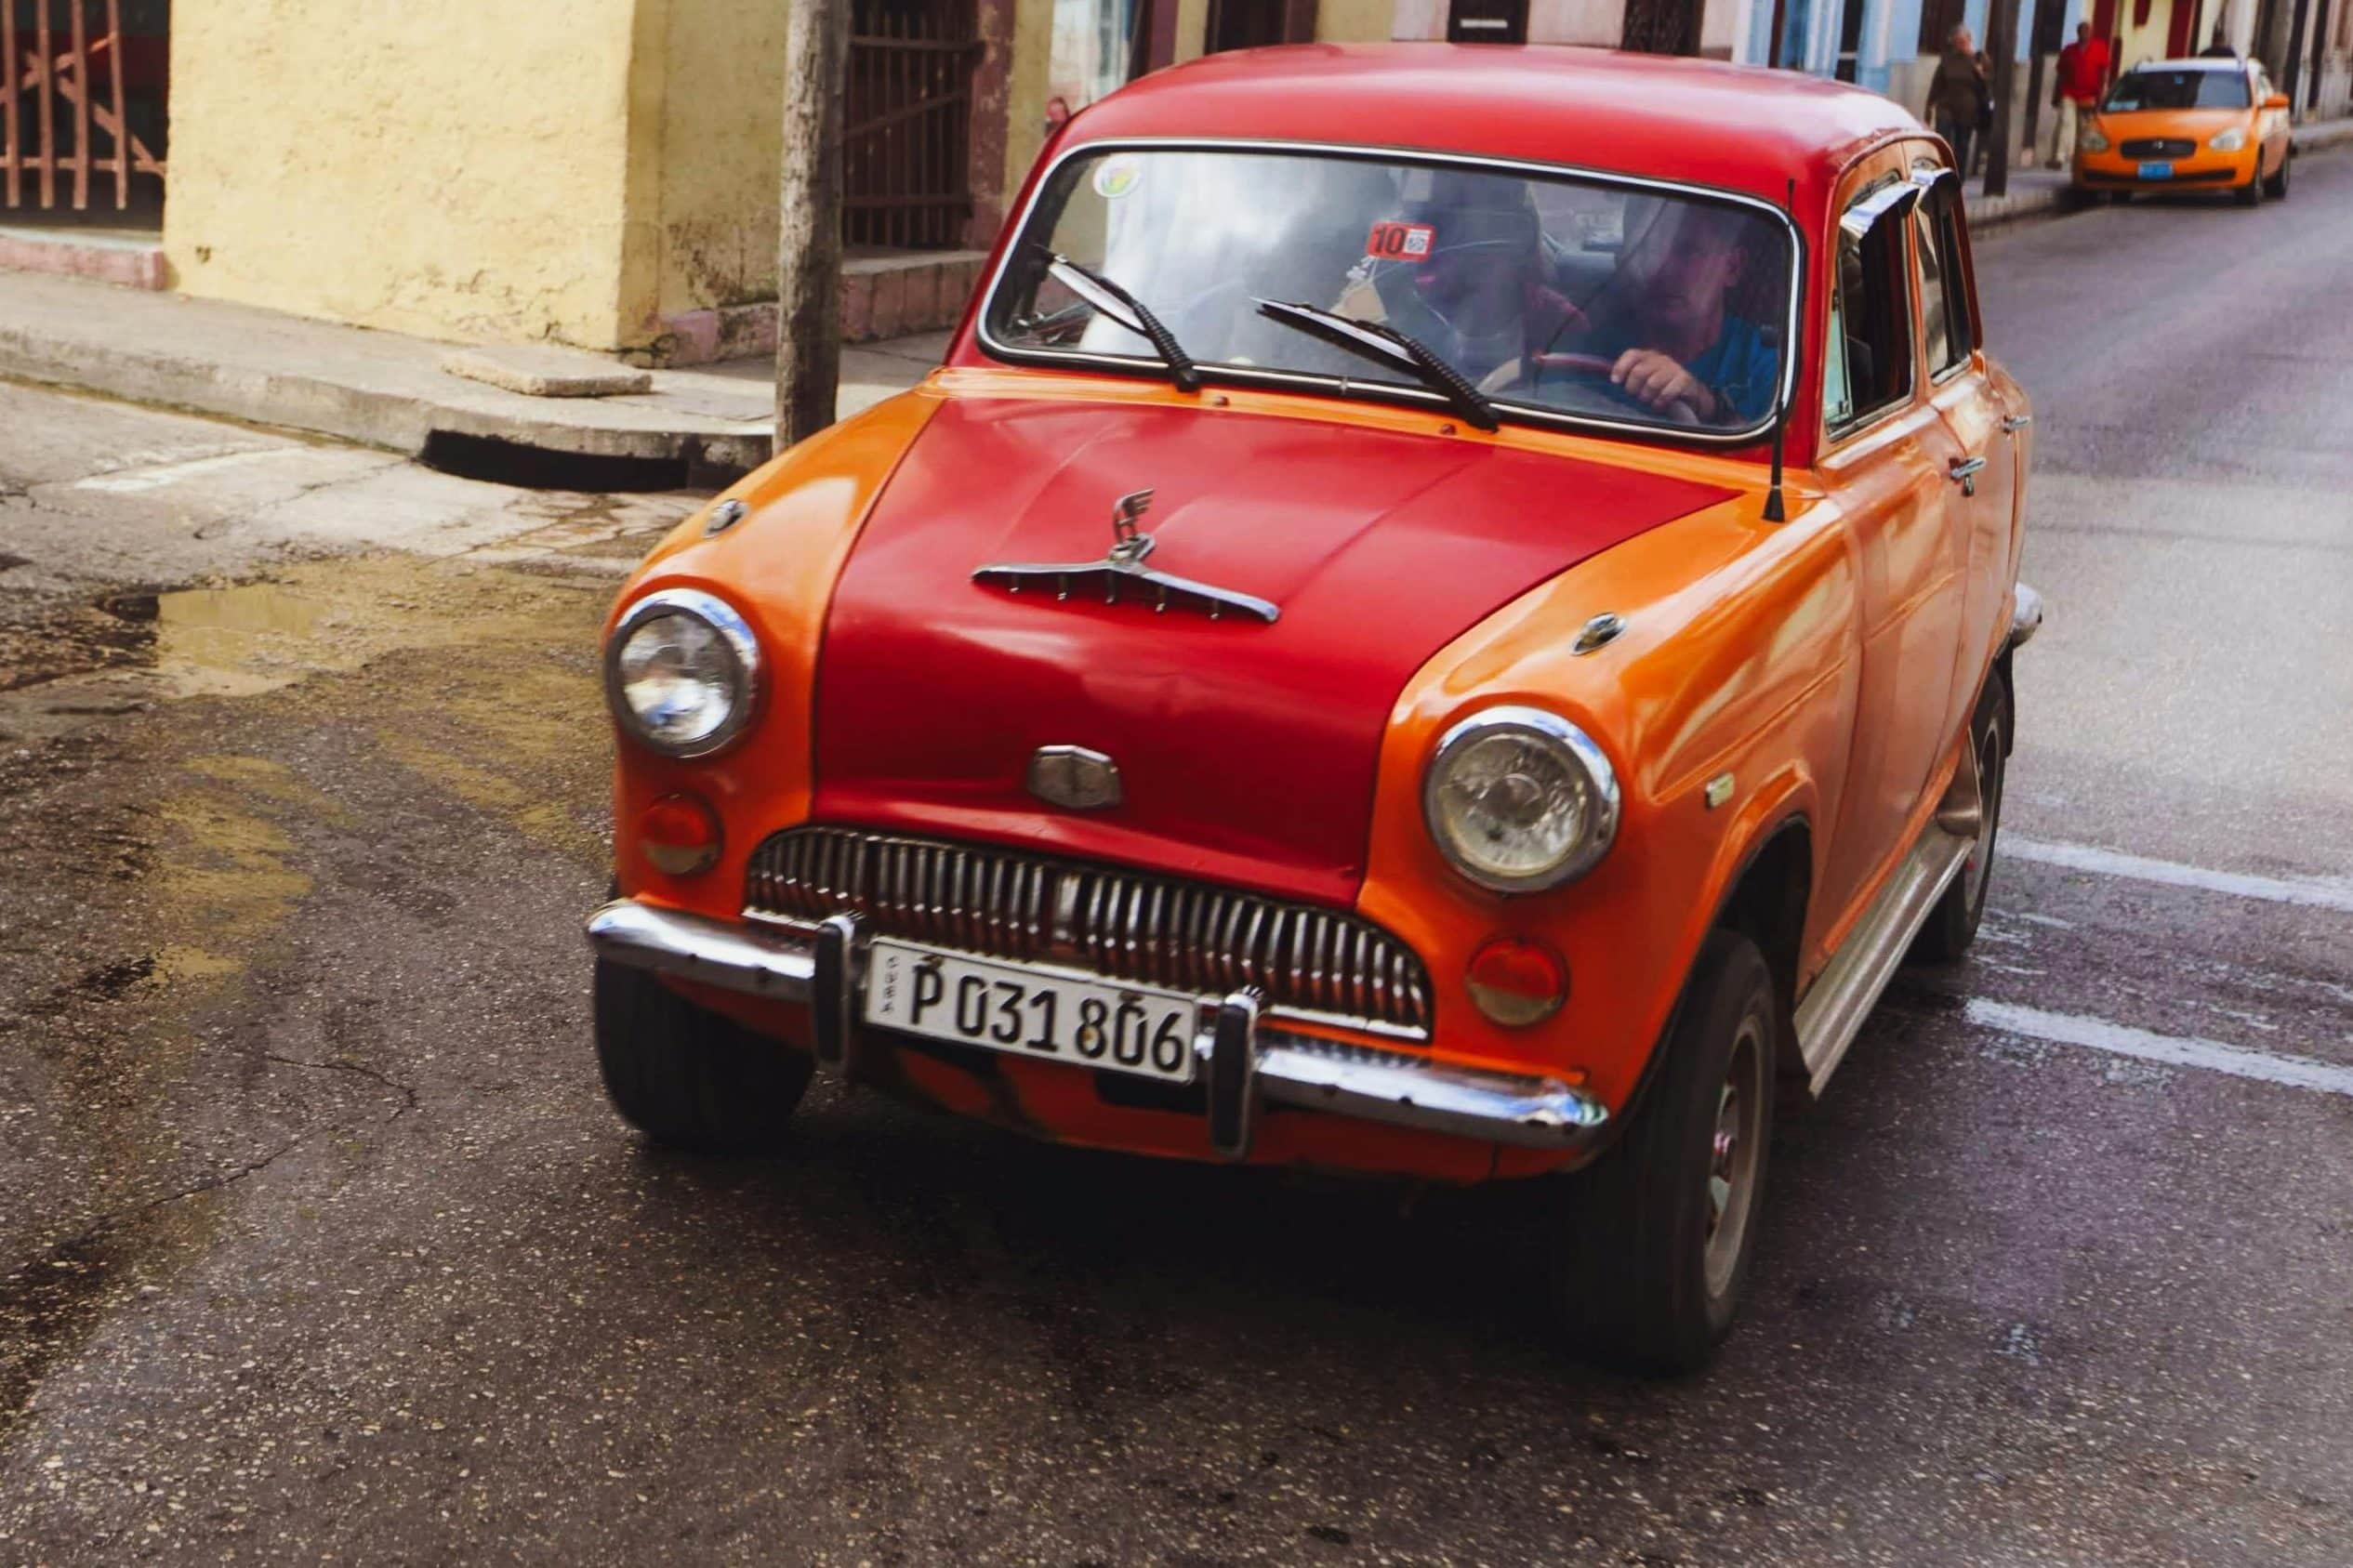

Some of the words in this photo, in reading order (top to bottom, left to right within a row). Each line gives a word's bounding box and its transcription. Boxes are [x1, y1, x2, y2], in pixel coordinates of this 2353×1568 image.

[1375, 226, 1407, 255] 10
[910, 964, 945, 1025] P
[956, 974, 1058, 1052] 031
[1075, 996, 1185, 1073] 806
